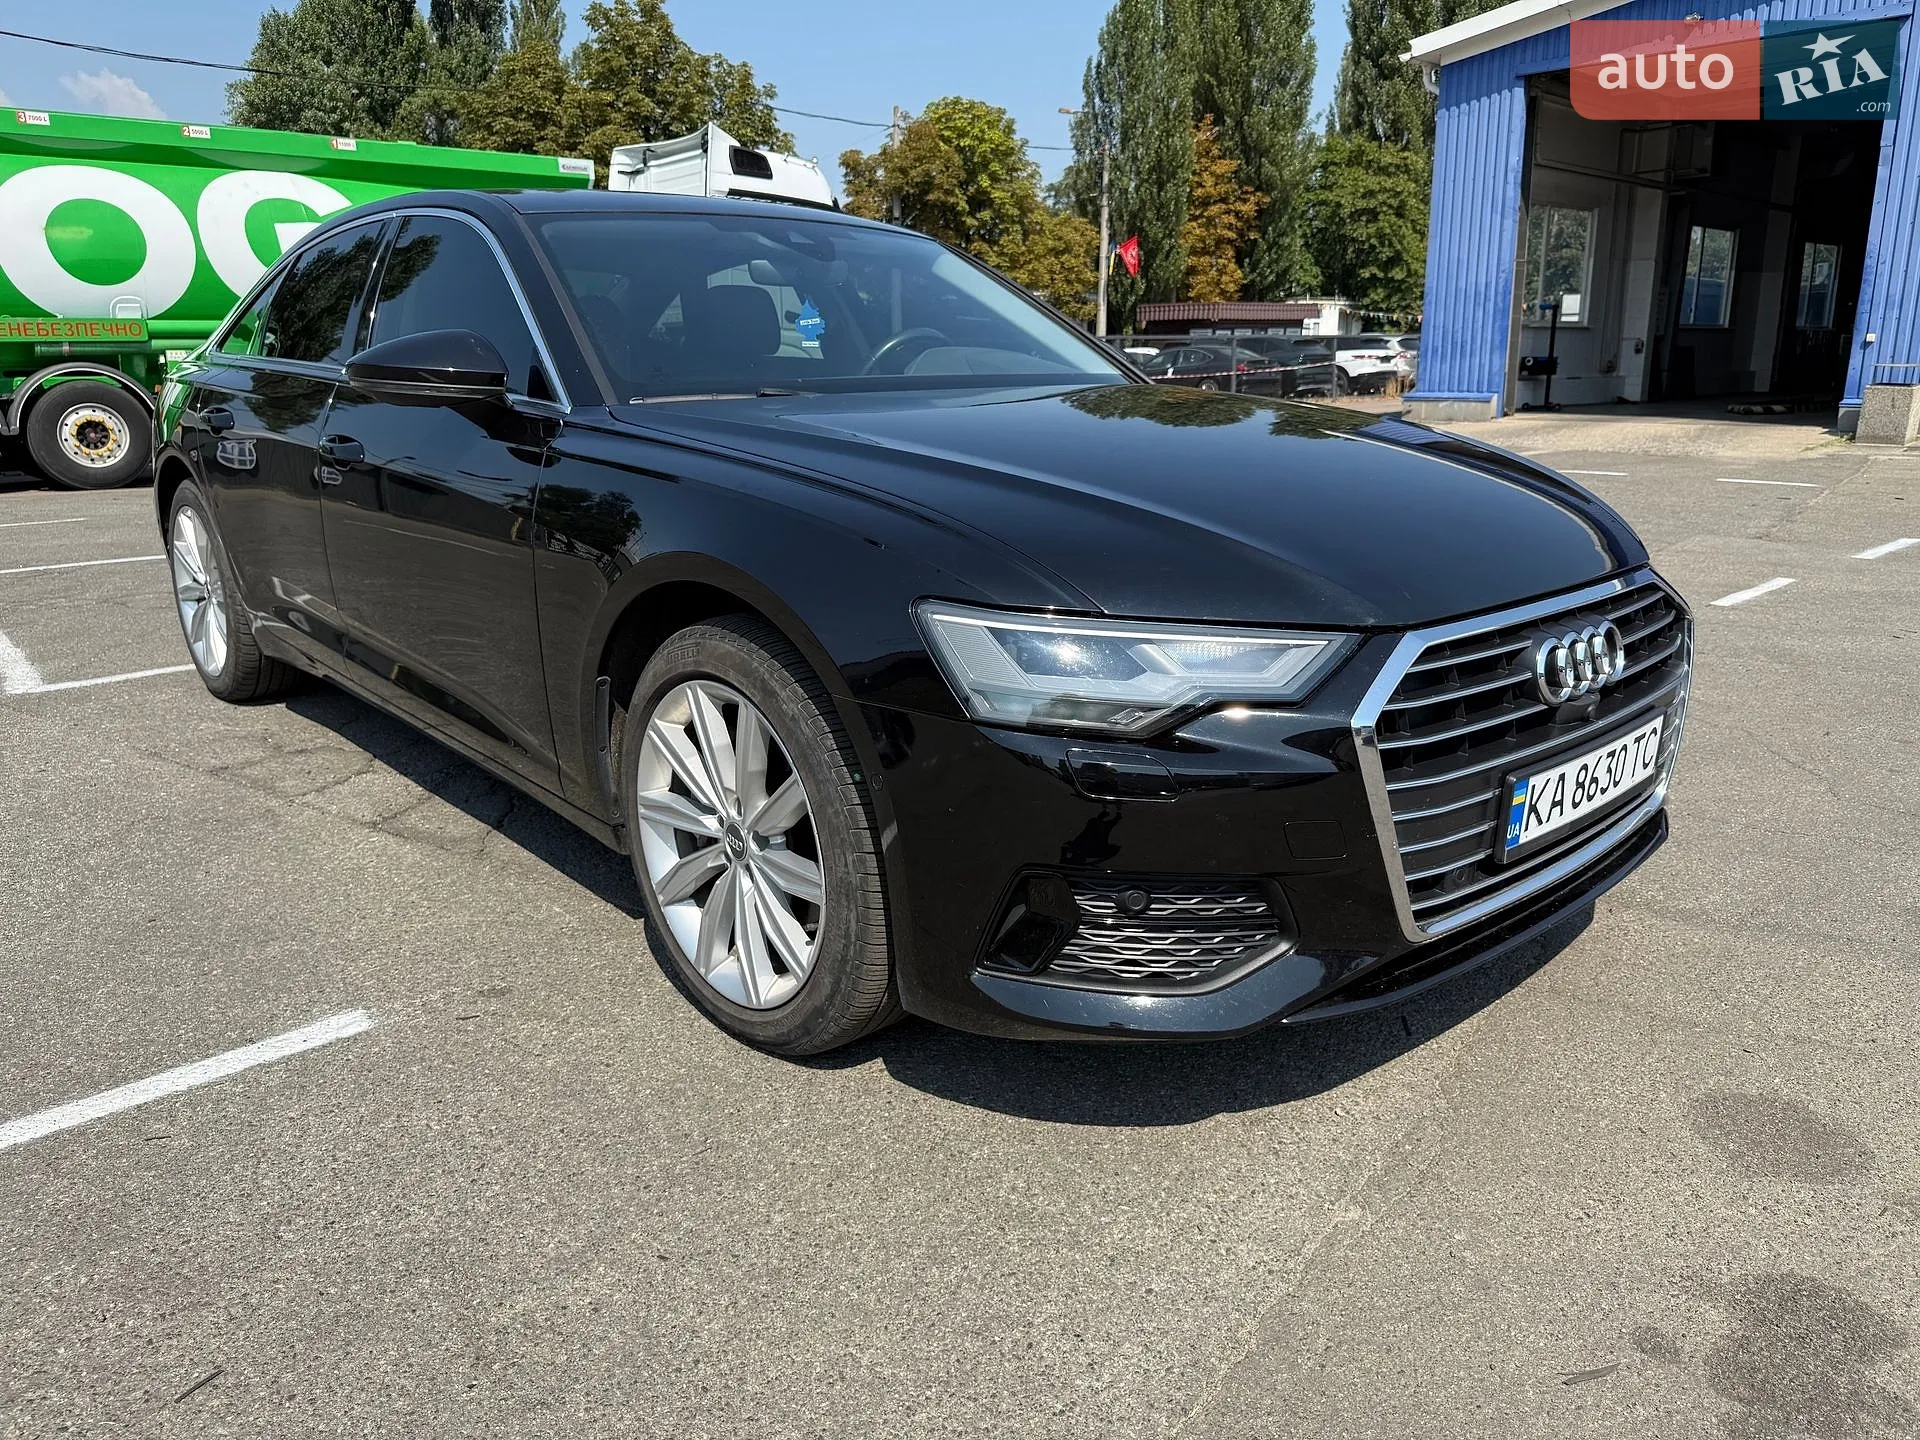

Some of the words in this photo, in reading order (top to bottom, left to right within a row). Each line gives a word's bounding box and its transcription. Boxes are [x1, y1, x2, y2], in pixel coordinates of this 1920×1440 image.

[18, 111, 26, 123] 3
[182, 126, 190, 136] 2
[1523, 772, 1566, 833] KA
[1571, 743, 1628, 810] 8630
[1631, 726, 1658, 780] TC
[1507, 822, 1520, 839] UA
